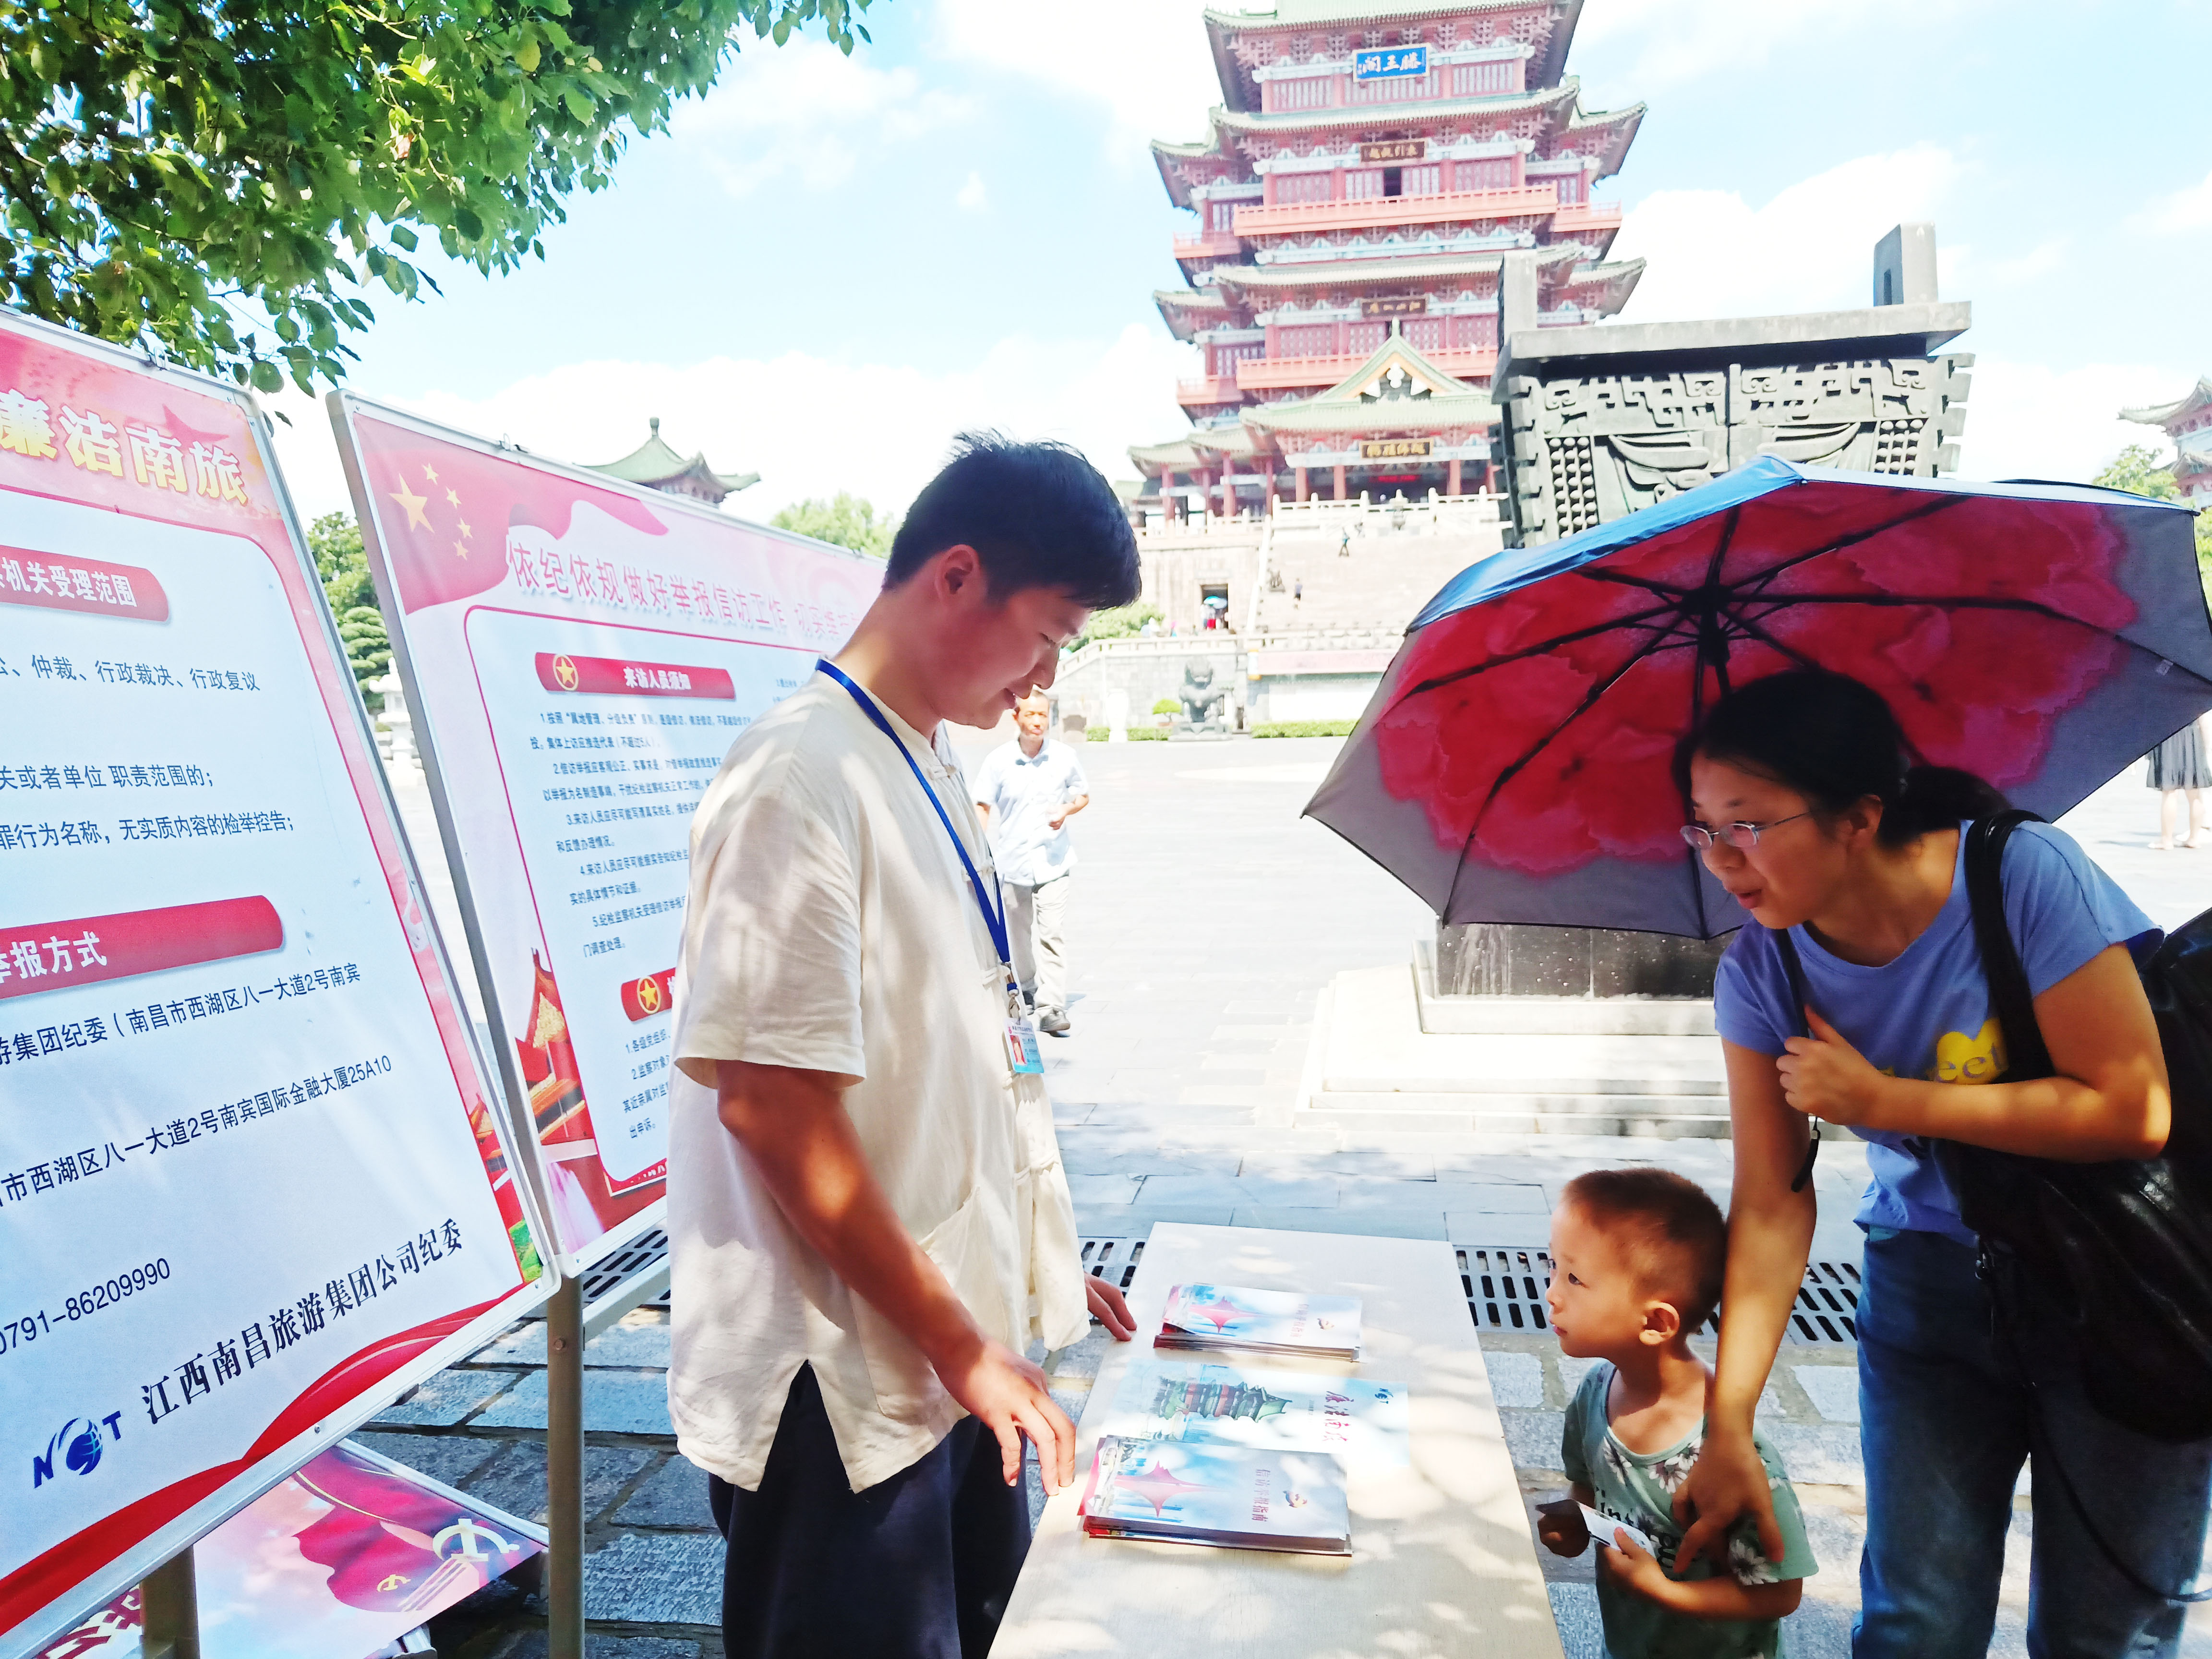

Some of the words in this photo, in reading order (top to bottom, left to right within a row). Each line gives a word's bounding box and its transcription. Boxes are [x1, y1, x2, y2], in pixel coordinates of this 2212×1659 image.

[0, 389, 248, 506] 廉洁南旅
[0, 557, 137, 607] 机关受理范围
[0, 1055, 392, 1207] 市西湖区八一大道2号南宾国际金融大厦25A10
[141, 1218, 463, 1424] 江西南昌旅游集团公司纪委
